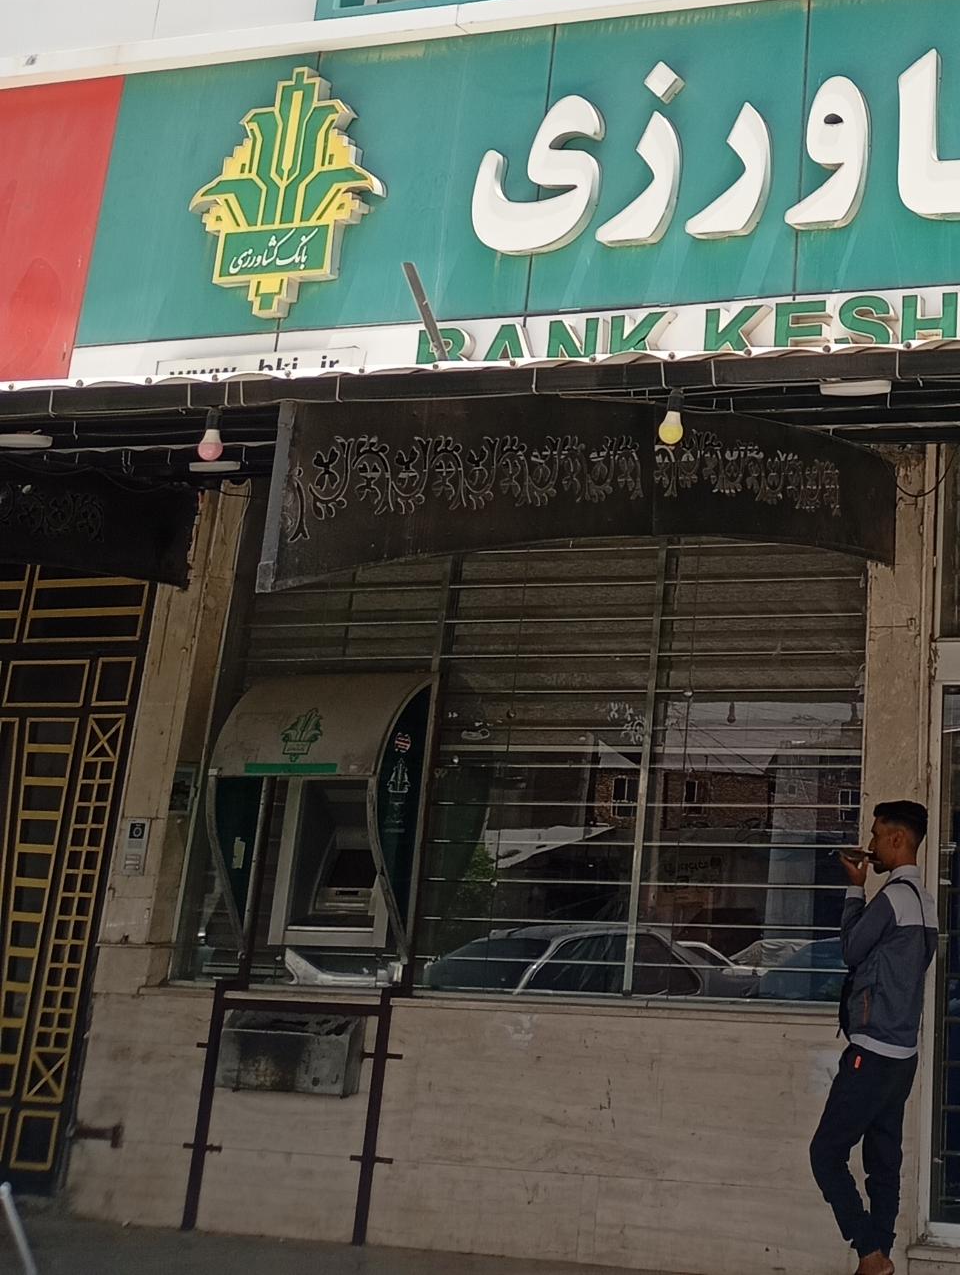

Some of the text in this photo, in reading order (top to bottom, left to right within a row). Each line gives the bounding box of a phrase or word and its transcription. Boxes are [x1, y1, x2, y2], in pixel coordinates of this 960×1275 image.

[229, 228, 319, 274] بانک کشاورزی
[415, 310, 672, 365] BANK
